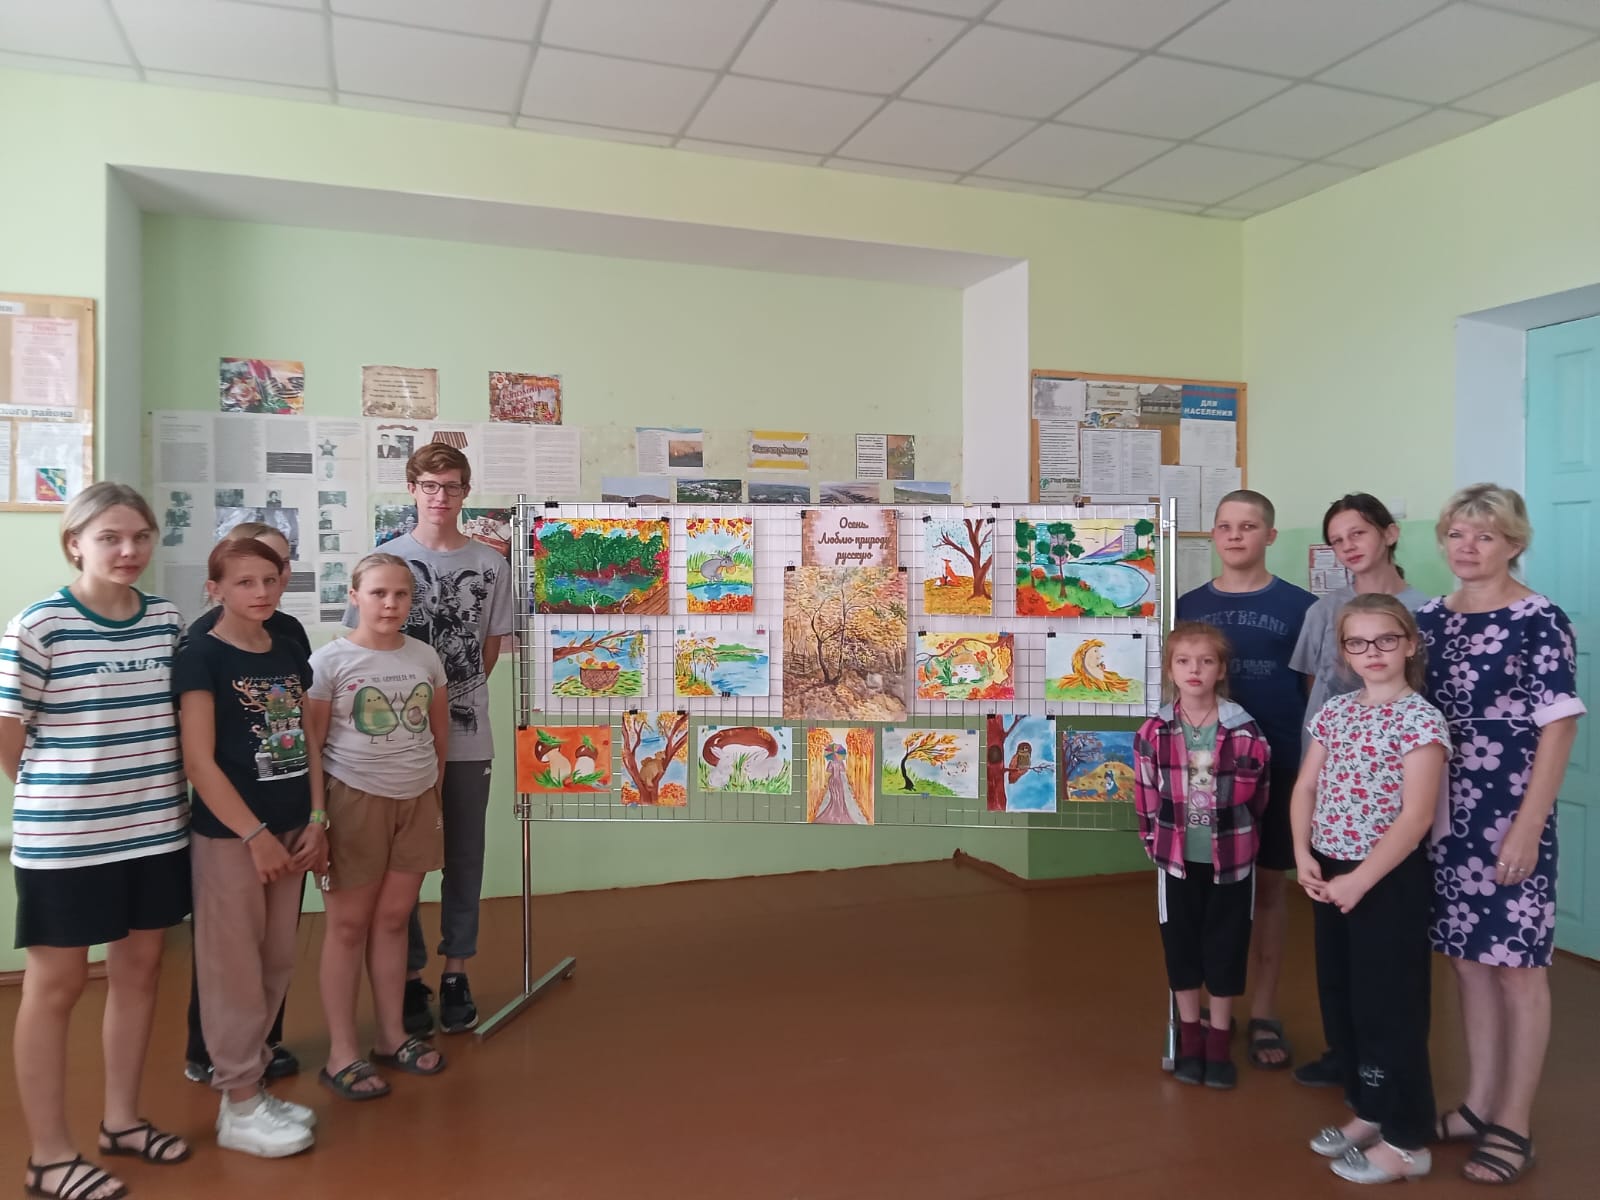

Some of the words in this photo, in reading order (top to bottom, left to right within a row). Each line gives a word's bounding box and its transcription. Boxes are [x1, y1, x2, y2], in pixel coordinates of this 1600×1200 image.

[1200, 399, 1218, 407] ДЛЯ
[1184, 407, 1233, 417] НАСЕЛЕНИЯ
[818, 531, 854, 544] Люблю
[855, 535, 891, 549] природу
[834, 551, 874, 565] русскую
